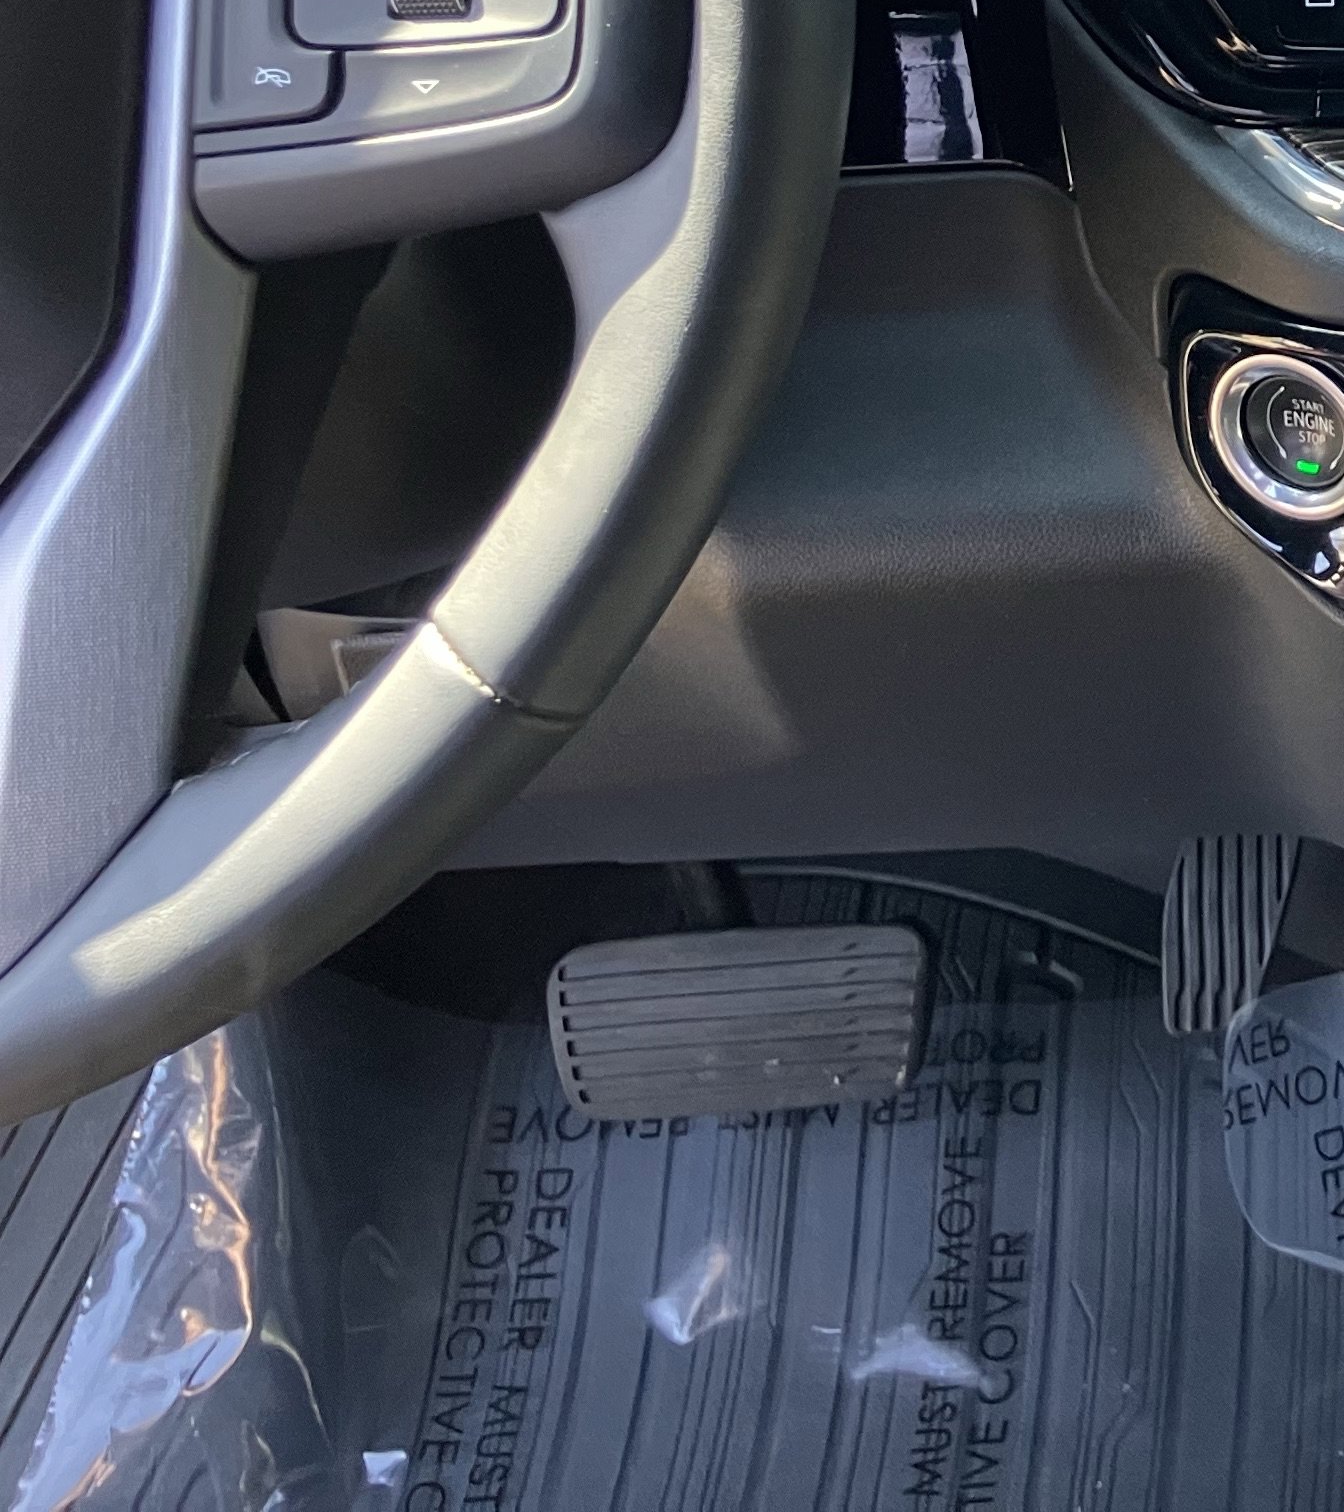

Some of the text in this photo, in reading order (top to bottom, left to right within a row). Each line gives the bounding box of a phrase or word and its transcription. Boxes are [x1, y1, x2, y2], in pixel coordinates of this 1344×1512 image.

[1291, 398, 1325, 416] START
[1283, 410, 1336, 438] ENGINE
[1298, 430, 1326, 445] STOP
[926, 1135, 985, 1343] REMOVE
[978, 1230, 1030, 1405] COVER
